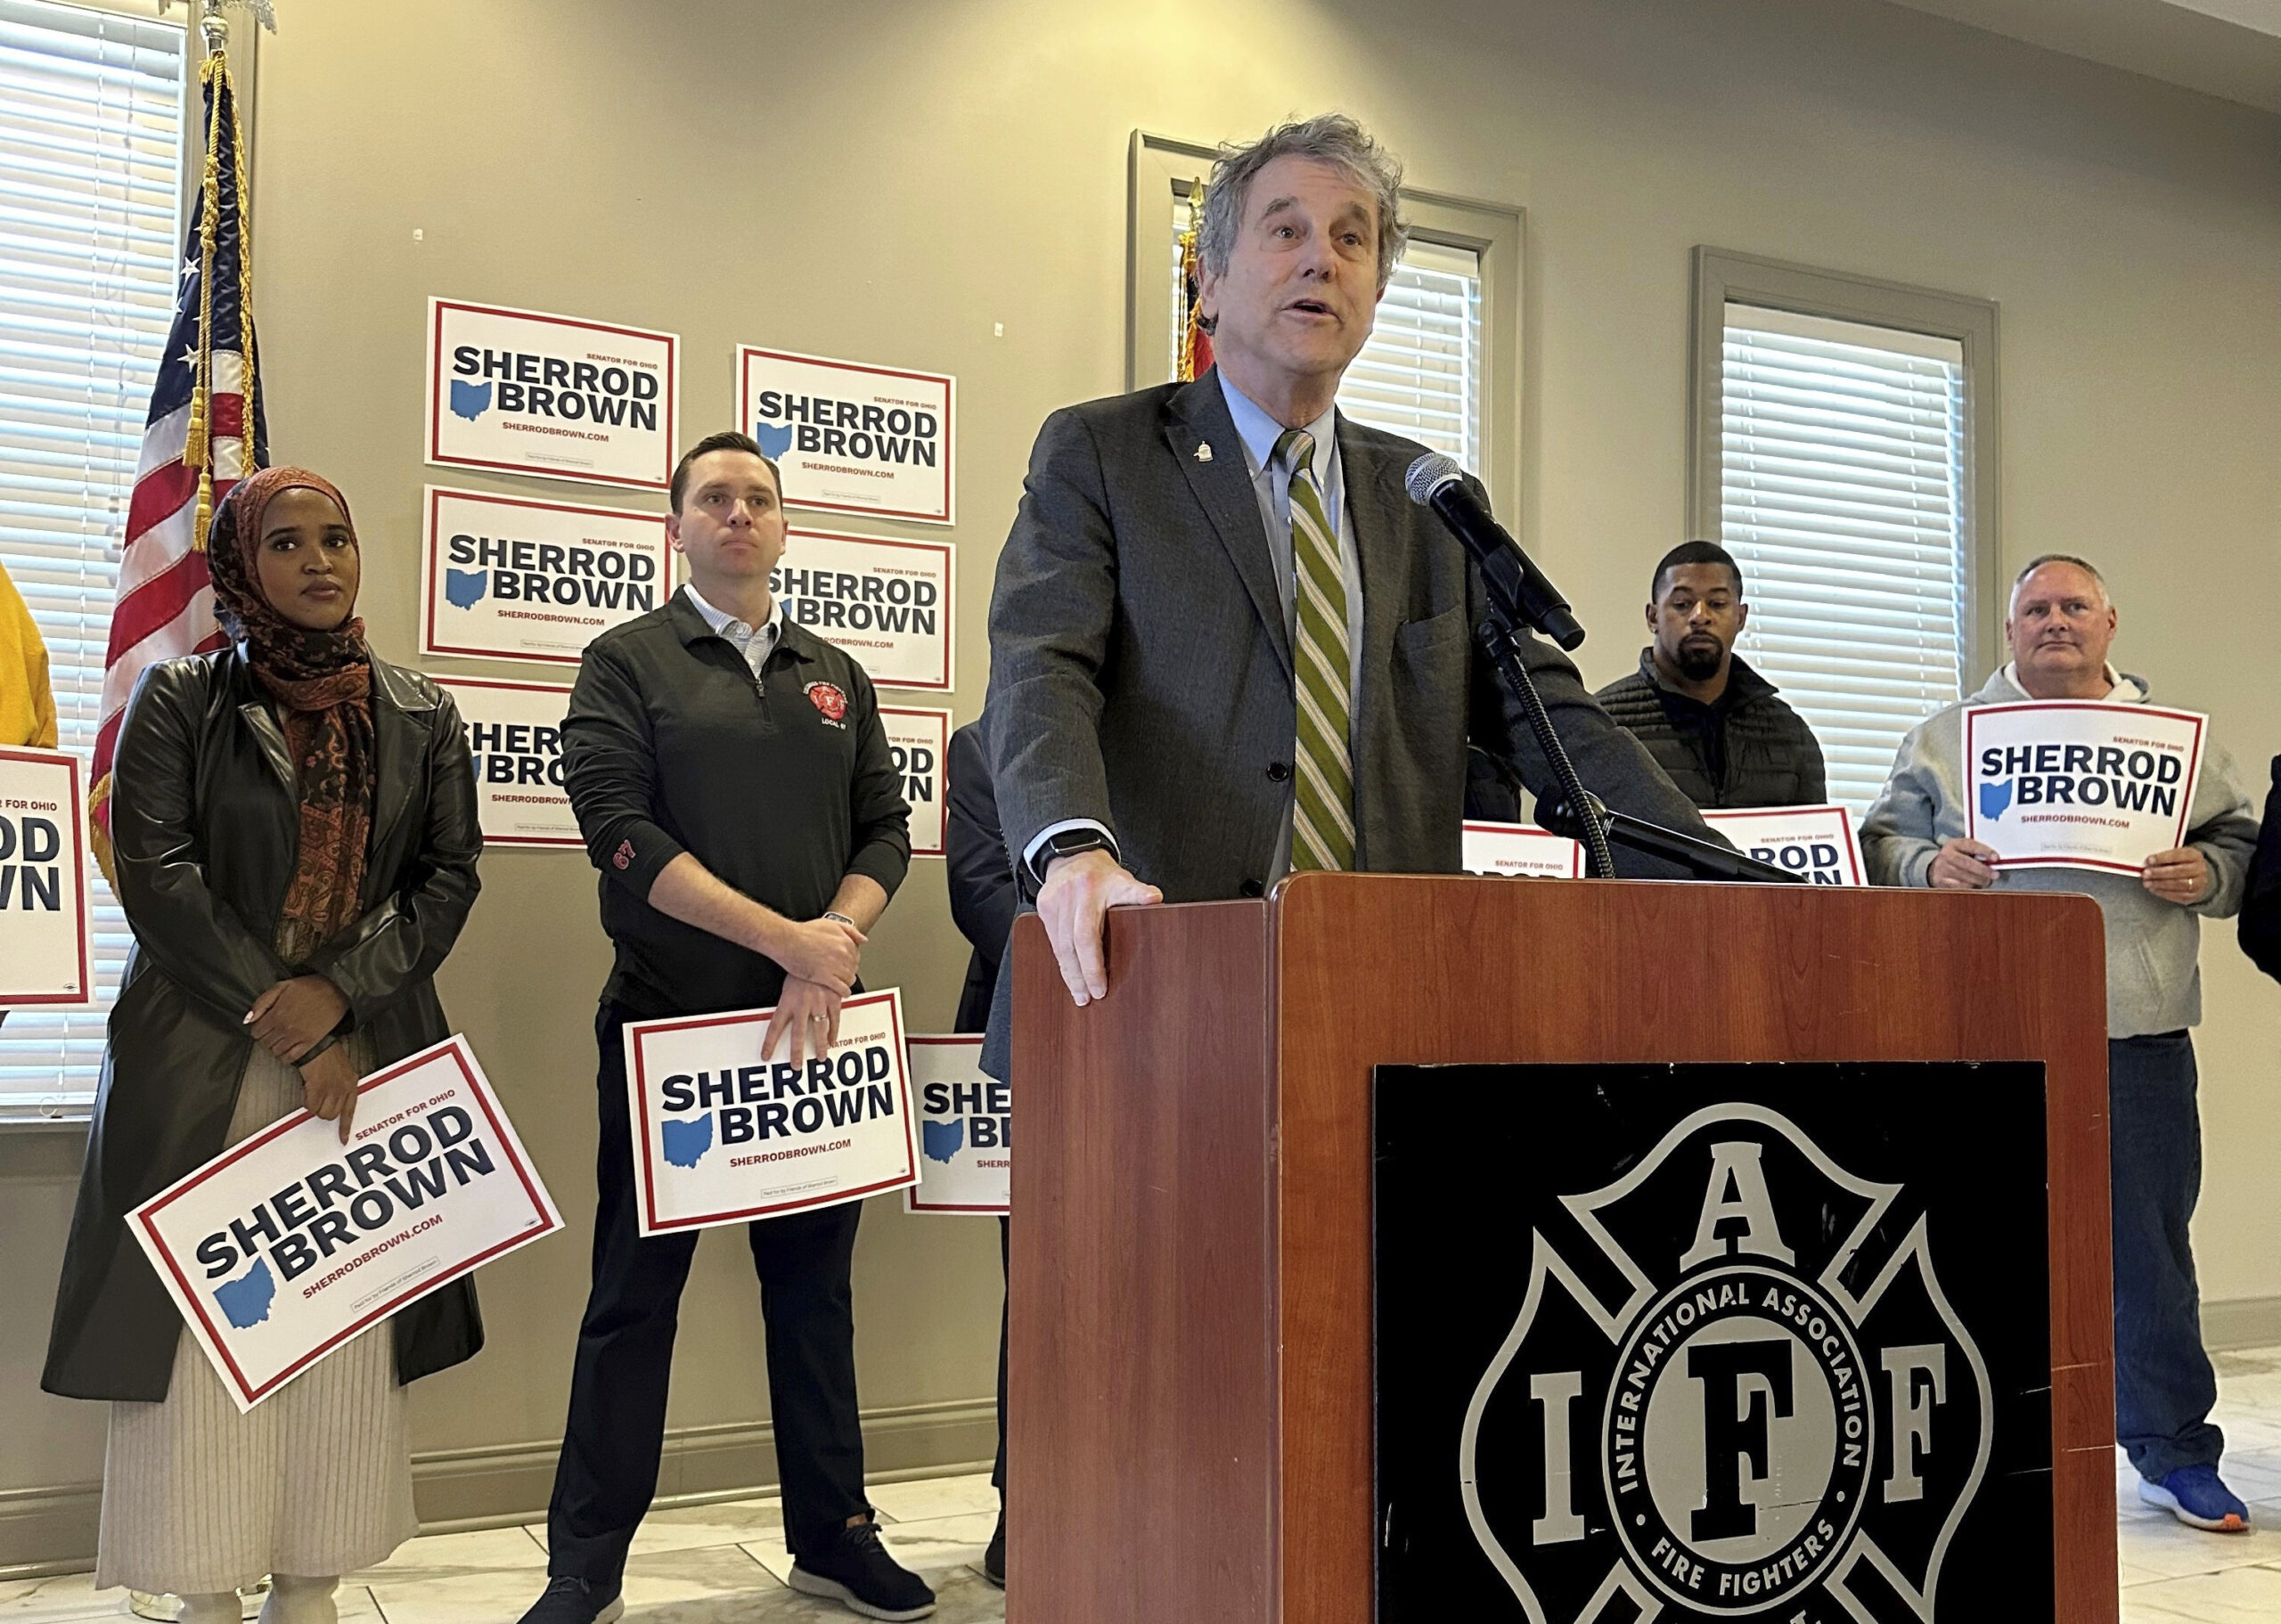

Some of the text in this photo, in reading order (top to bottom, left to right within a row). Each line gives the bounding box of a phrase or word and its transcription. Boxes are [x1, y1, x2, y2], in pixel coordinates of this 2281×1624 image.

[453, 346, 658, 401] SHERROD
[586, 354, 658, 370] SENATOR FOR OHIO
[497, 381, 656, 431] BROWN
[758, 391, 937, 438] SHERROD
[873, 396, 904, 405] SENATOR
[502, 421, 609, 442] SHERRODBROWN.COM
[797, 424, 936, 468] BROWN
[802, 461, 895, 479] SHERRODBROWN.COM
[448, 535, 655, 582] SHERROD
[582, 538, 617, 546] SENATOR
[493, 570, 653, 611] BROWN
[873, 567, 903, 575] SENATOR
[497, 609, 605, 626] SHERRODBROWN.COM
[797, 598, 936, 635] BROWN
[1981, 745, 2181, 785] SHERROD
[2113, 736, 2184, 753] SENATOR FOR OHIO
[5, 800, 28, 810] FOR
[31, 801, 57, 812] OHIO
[2017, 775, 2177, 817] BROWN
[2021, 814, 2130, 829] SHERRODBROWN.COM
[613, 839, 636, 869] 67
[1495, 860, 1527, 869] SENATOR
[854, 1035, 869, 1044] FOR
[870, 1032, 886, 1041] OHIO
[661, 1046, 890, 1112] SHERROD
[356, 1089, 455, 1140] SENATOR FOR OHIO
[720, 1081, 894, 1145] BROWN
[730, 1138, 852, 1167] SHERRODBROWN.COM
[195, 1106, 473, 1279] SHERROD
[268, 1138, 495, 1282] BROWN
[1680, 1141, 1795, 1273] A
[302, 1213, 444, 1299] SHERRODBROWN.COM
[1615, 1283, 1862, 1494] INTERNATIONAL ASSOCIATION
[1688, 1339, 1795, 1542] F
[1881, 1342, 1946, 1504] F
[1530, 1371, 1585, 1546] I
[1651, 1518, 1834, 1596] FIRE FIGHTERS
